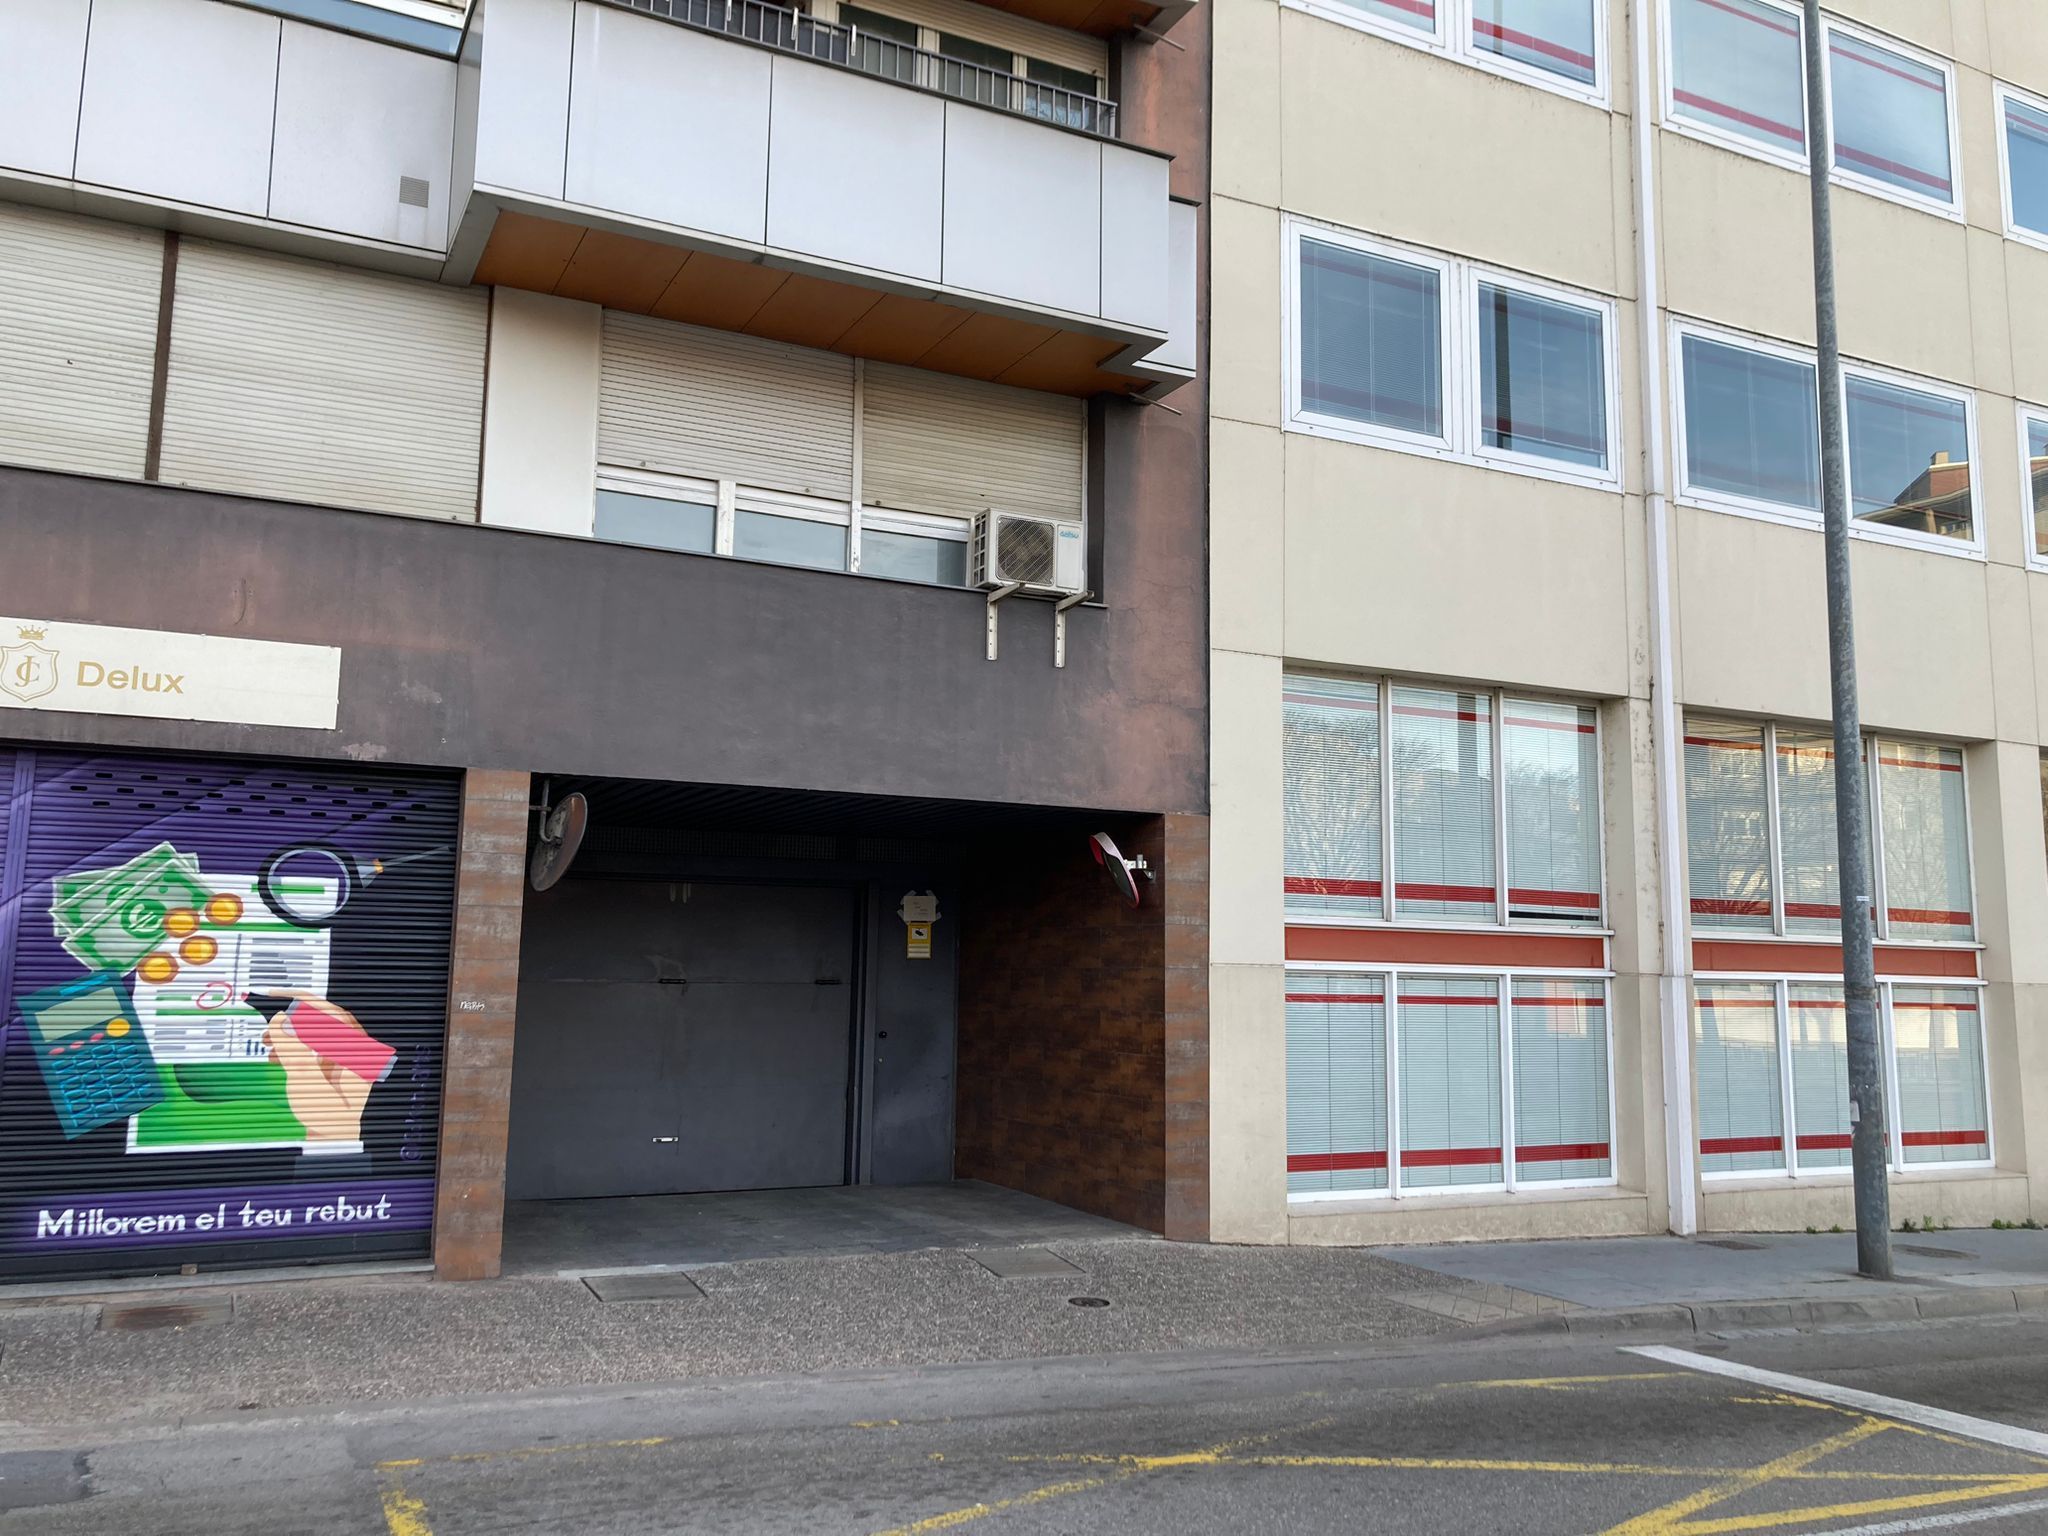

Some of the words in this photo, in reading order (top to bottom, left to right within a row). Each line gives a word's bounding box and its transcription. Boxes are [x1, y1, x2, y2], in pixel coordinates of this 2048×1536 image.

[76, 660, 185, 694] Delux
[36, 1208, 186, 1239] Millorem
[194, 1203, 226, 1231] el
[238, 1200, 292, 1227] teu
[304, 1193, 392, 1224] rebut
